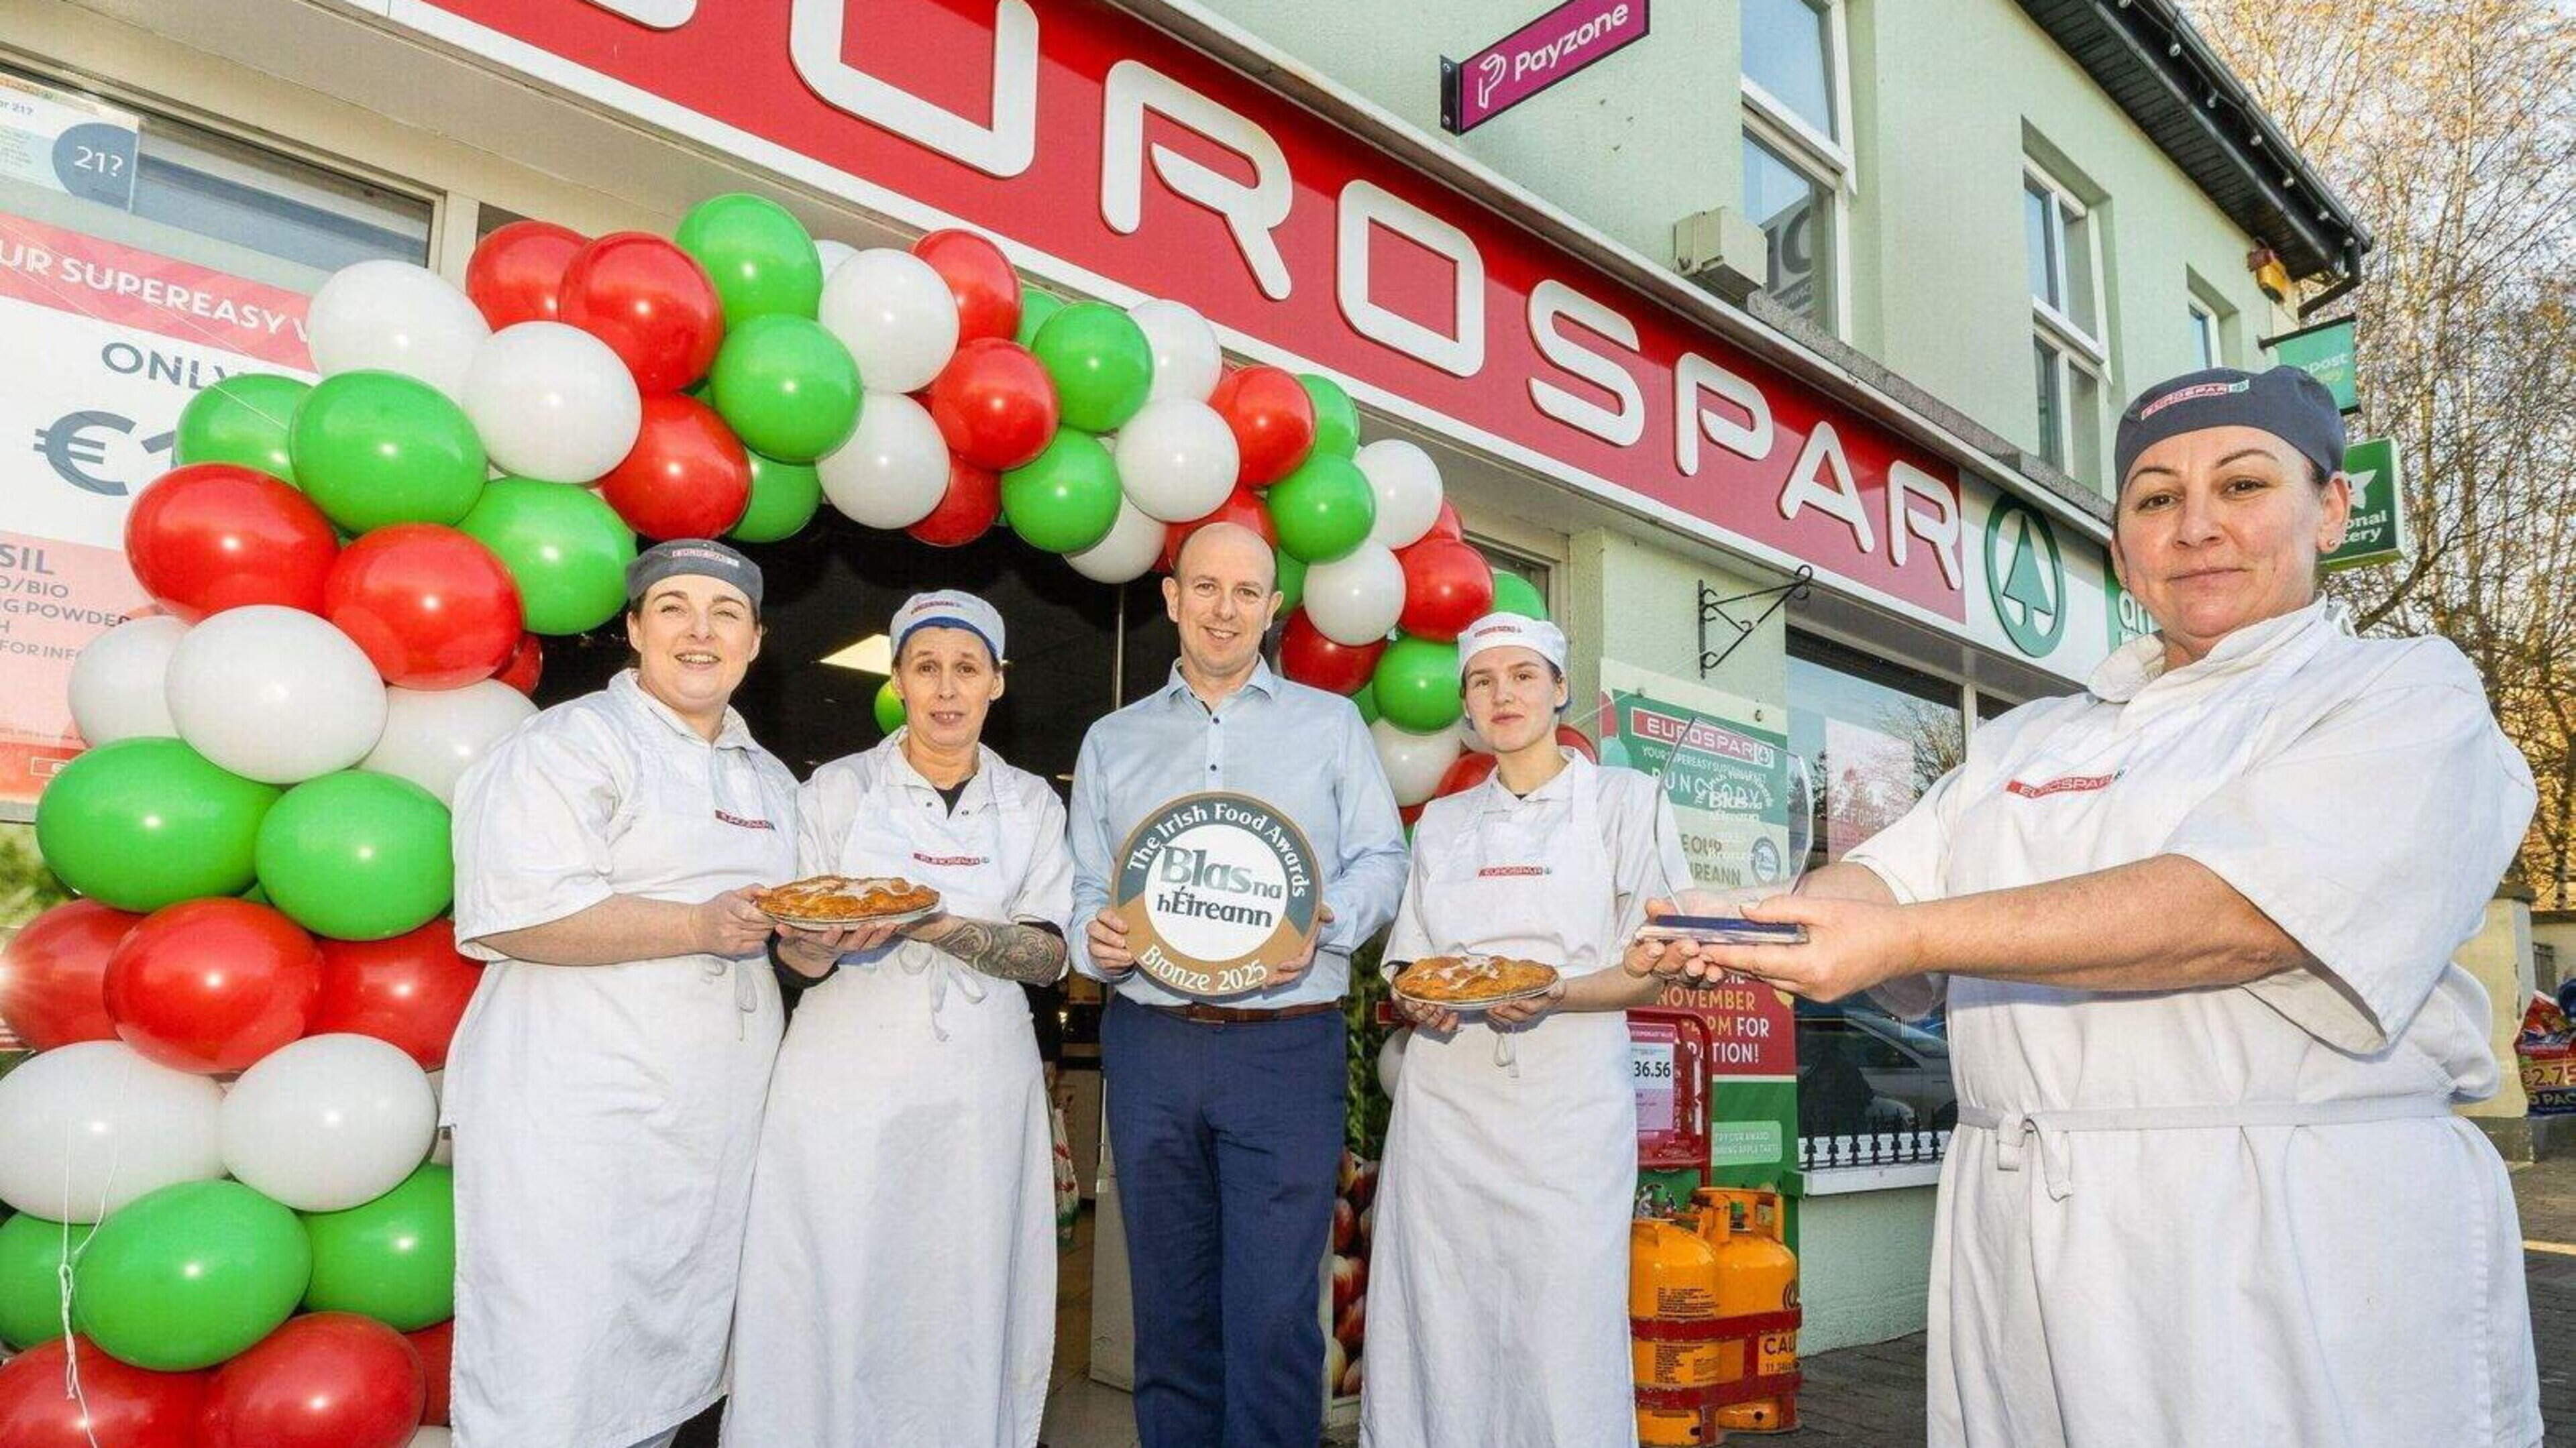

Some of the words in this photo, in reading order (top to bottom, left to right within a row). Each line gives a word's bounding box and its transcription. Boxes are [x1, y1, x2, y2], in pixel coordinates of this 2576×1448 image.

[1514, 3, 1629, 82] Payzone
[73, 145, 123, 178] 21?
[61, 257, 286, 334] SUPEREASY
[578, 0, 1962, 591] UROSPAR
[2344, 510, 2387, 529] onal
[1647, 717, 1754, 758] EUROSPAR
[1127, 836, 1160, 872] The
[1158, 805, 1208, 838] Irish
[1214, 803, 1268, 829] Food
[1267, 824, 1309, 897] Awards
[1161, 844, 1252, 895] Blas
[1252, 881, 1282, 899] na
[1157, 886, 1273, 928] hÉireann
[1140, 944, 1211, 991] Bronze
[1217, 959, 1268, 992] 2025
[1657, 986, 1756, 1011] NOVEMBER
[1737, 1017, 1770, 1038] FOR
[1633, 1061, 1672, 1078] 36.56
